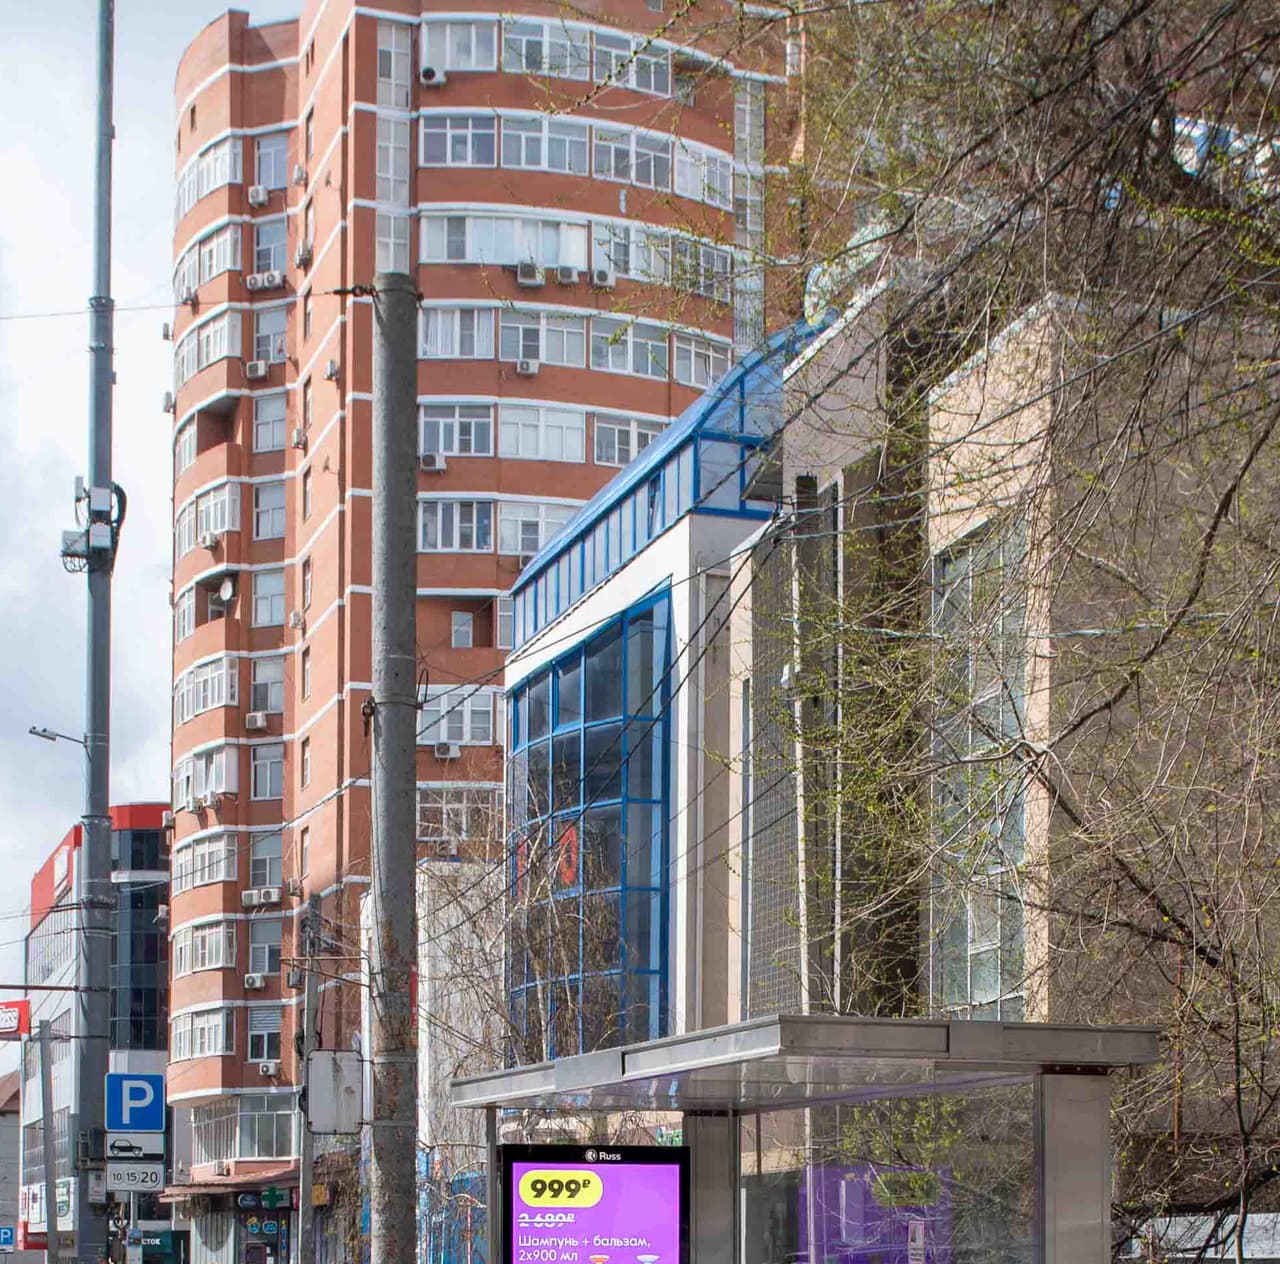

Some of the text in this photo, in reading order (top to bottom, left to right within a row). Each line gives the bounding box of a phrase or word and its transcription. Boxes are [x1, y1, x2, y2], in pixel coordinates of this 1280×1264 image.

[122, 1080, 154, 1124] P
[599, 1152, 621, 1161] Russ
[113, 1171, 159, 1184] 10 15 20
[0, 1229, 11, 1243] P
[518, 1235, 579, 1249] Шампунь
[593, 1235, 651, 1248] бальзам,
[560, 1253, 578, 1262] мл
